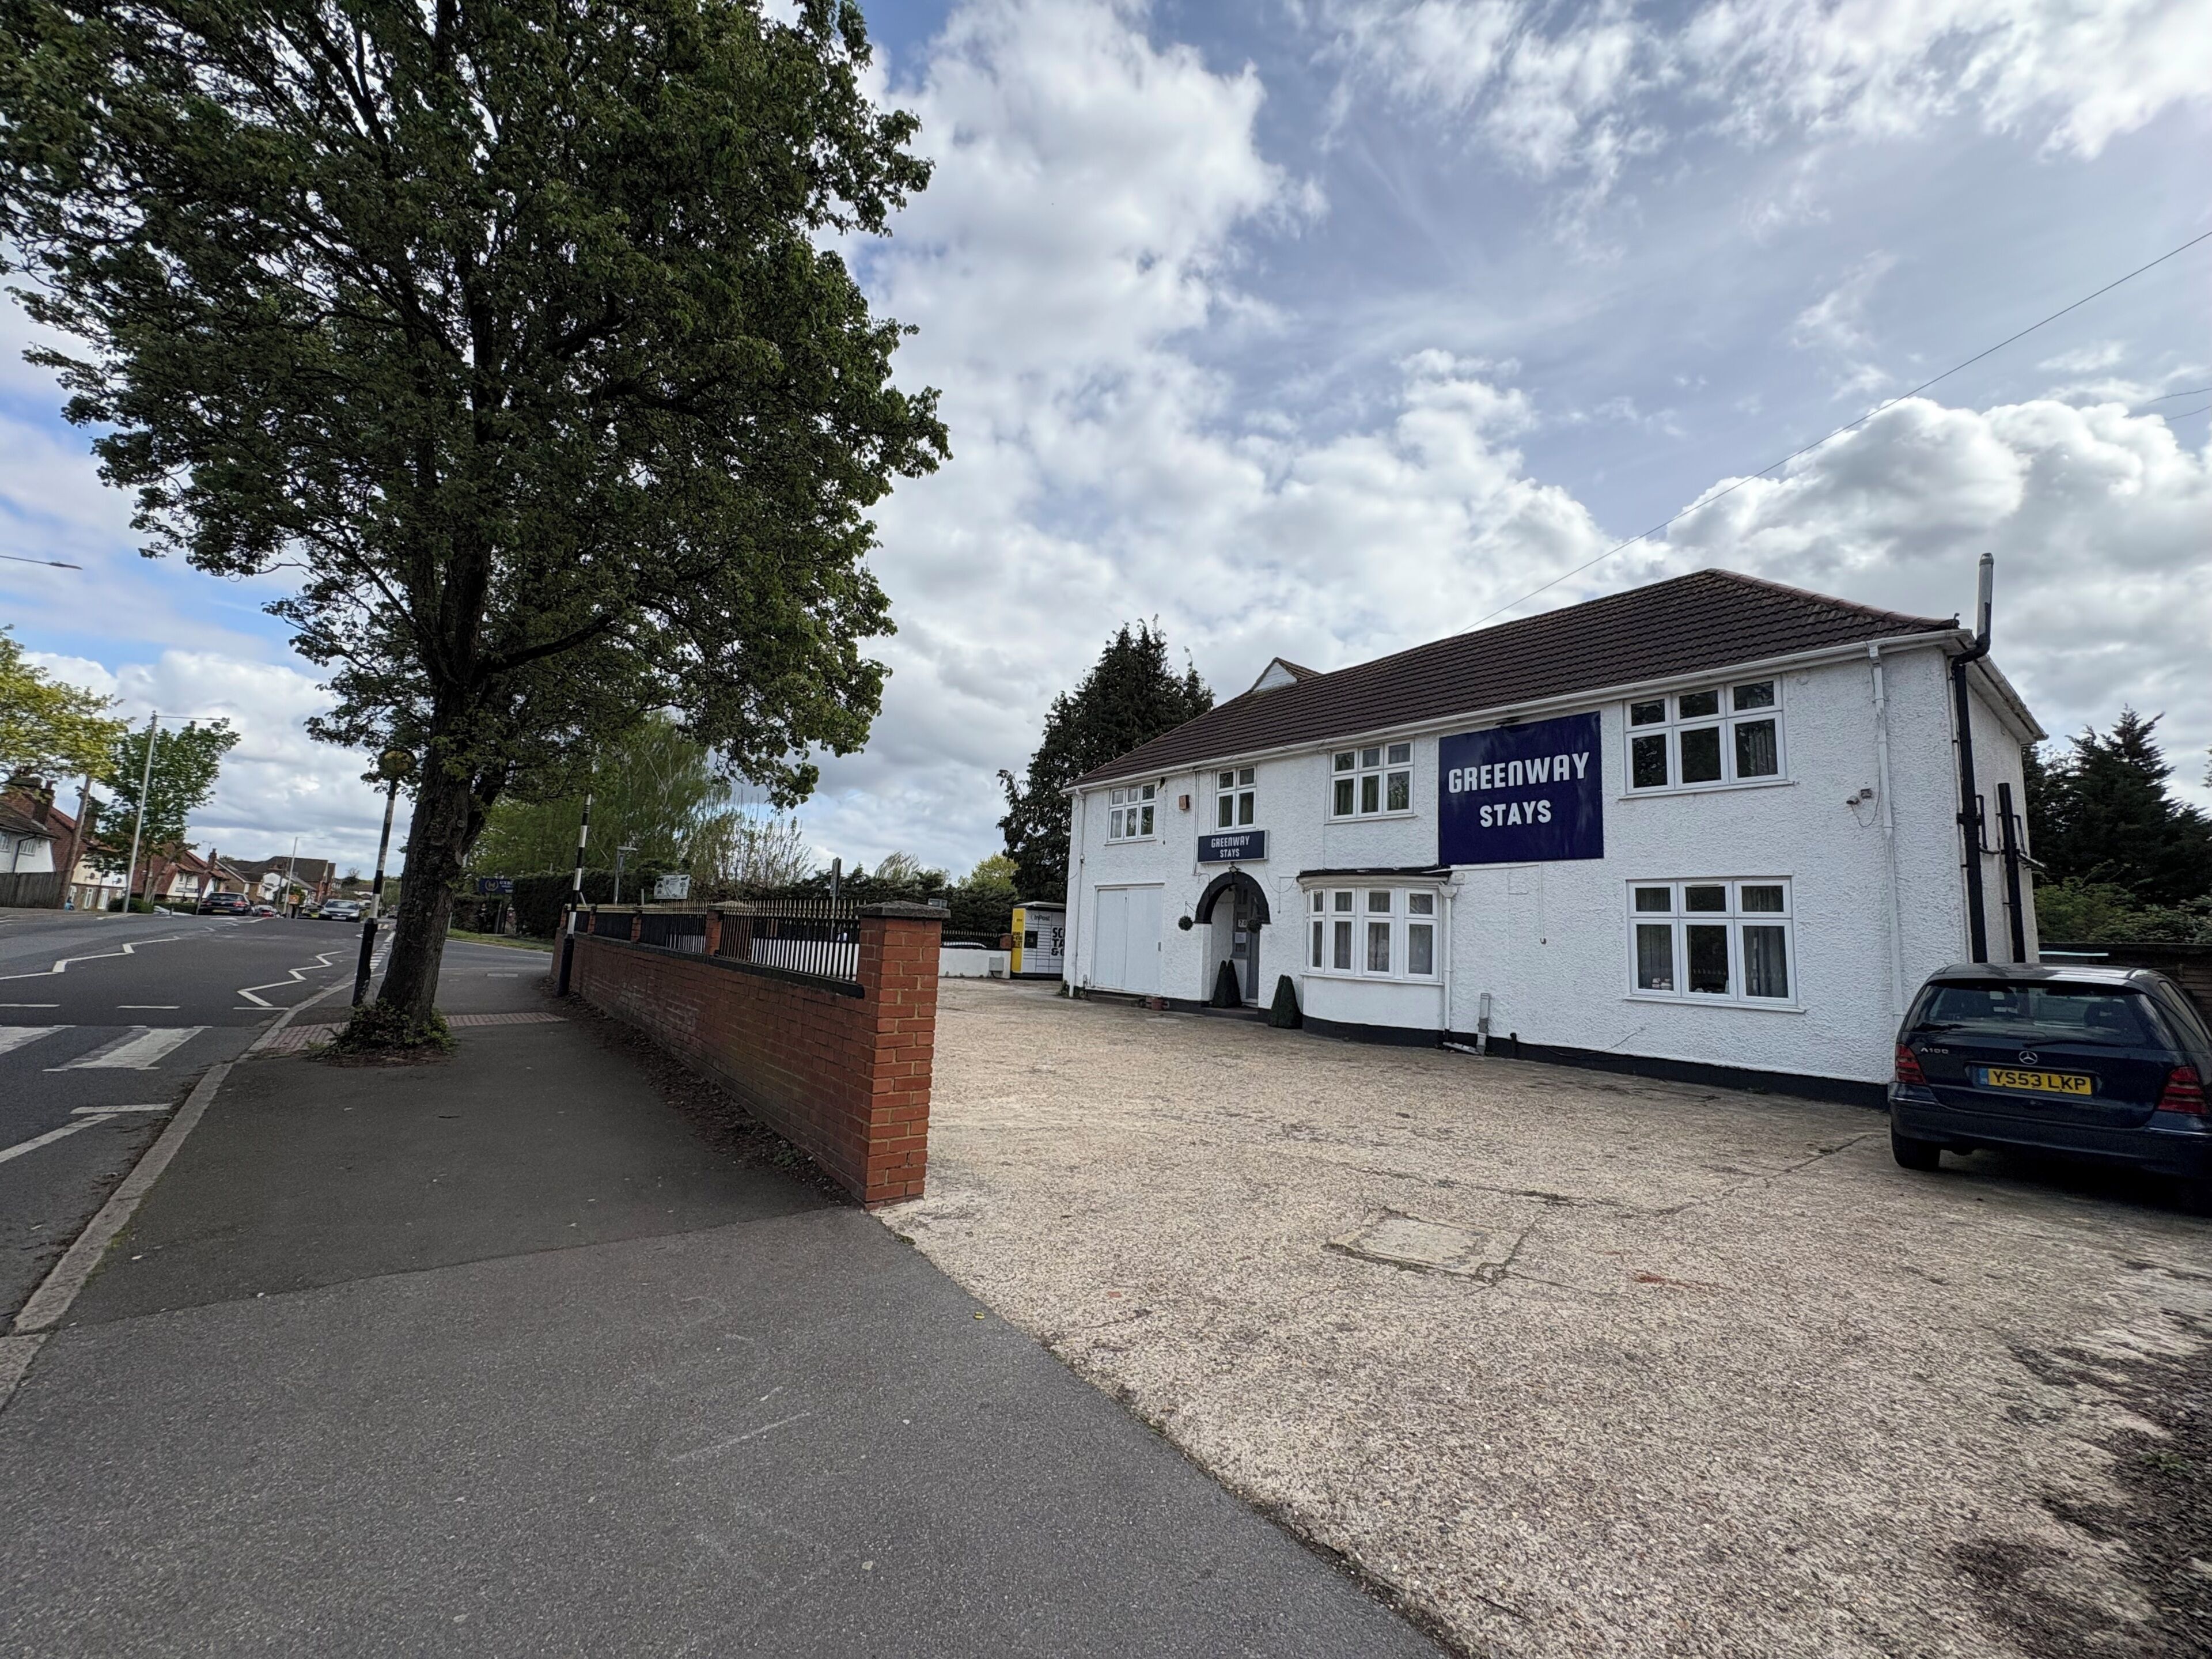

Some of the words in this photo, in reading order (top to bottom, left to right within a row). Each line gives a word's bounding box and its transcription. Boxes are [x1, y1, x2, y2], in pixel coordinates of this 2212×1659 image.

[1448, 752, 1589, 794] GREENWAY
[1480, 800, 1551, 827] STAYS
[1211, 835, 1250, 848] GREENWAY
[1220, 848, 1240, 858] STAYS
[1993, 1070, 2042, 1086] YS53
[2048, 1075, 2086, 1090] LKP
